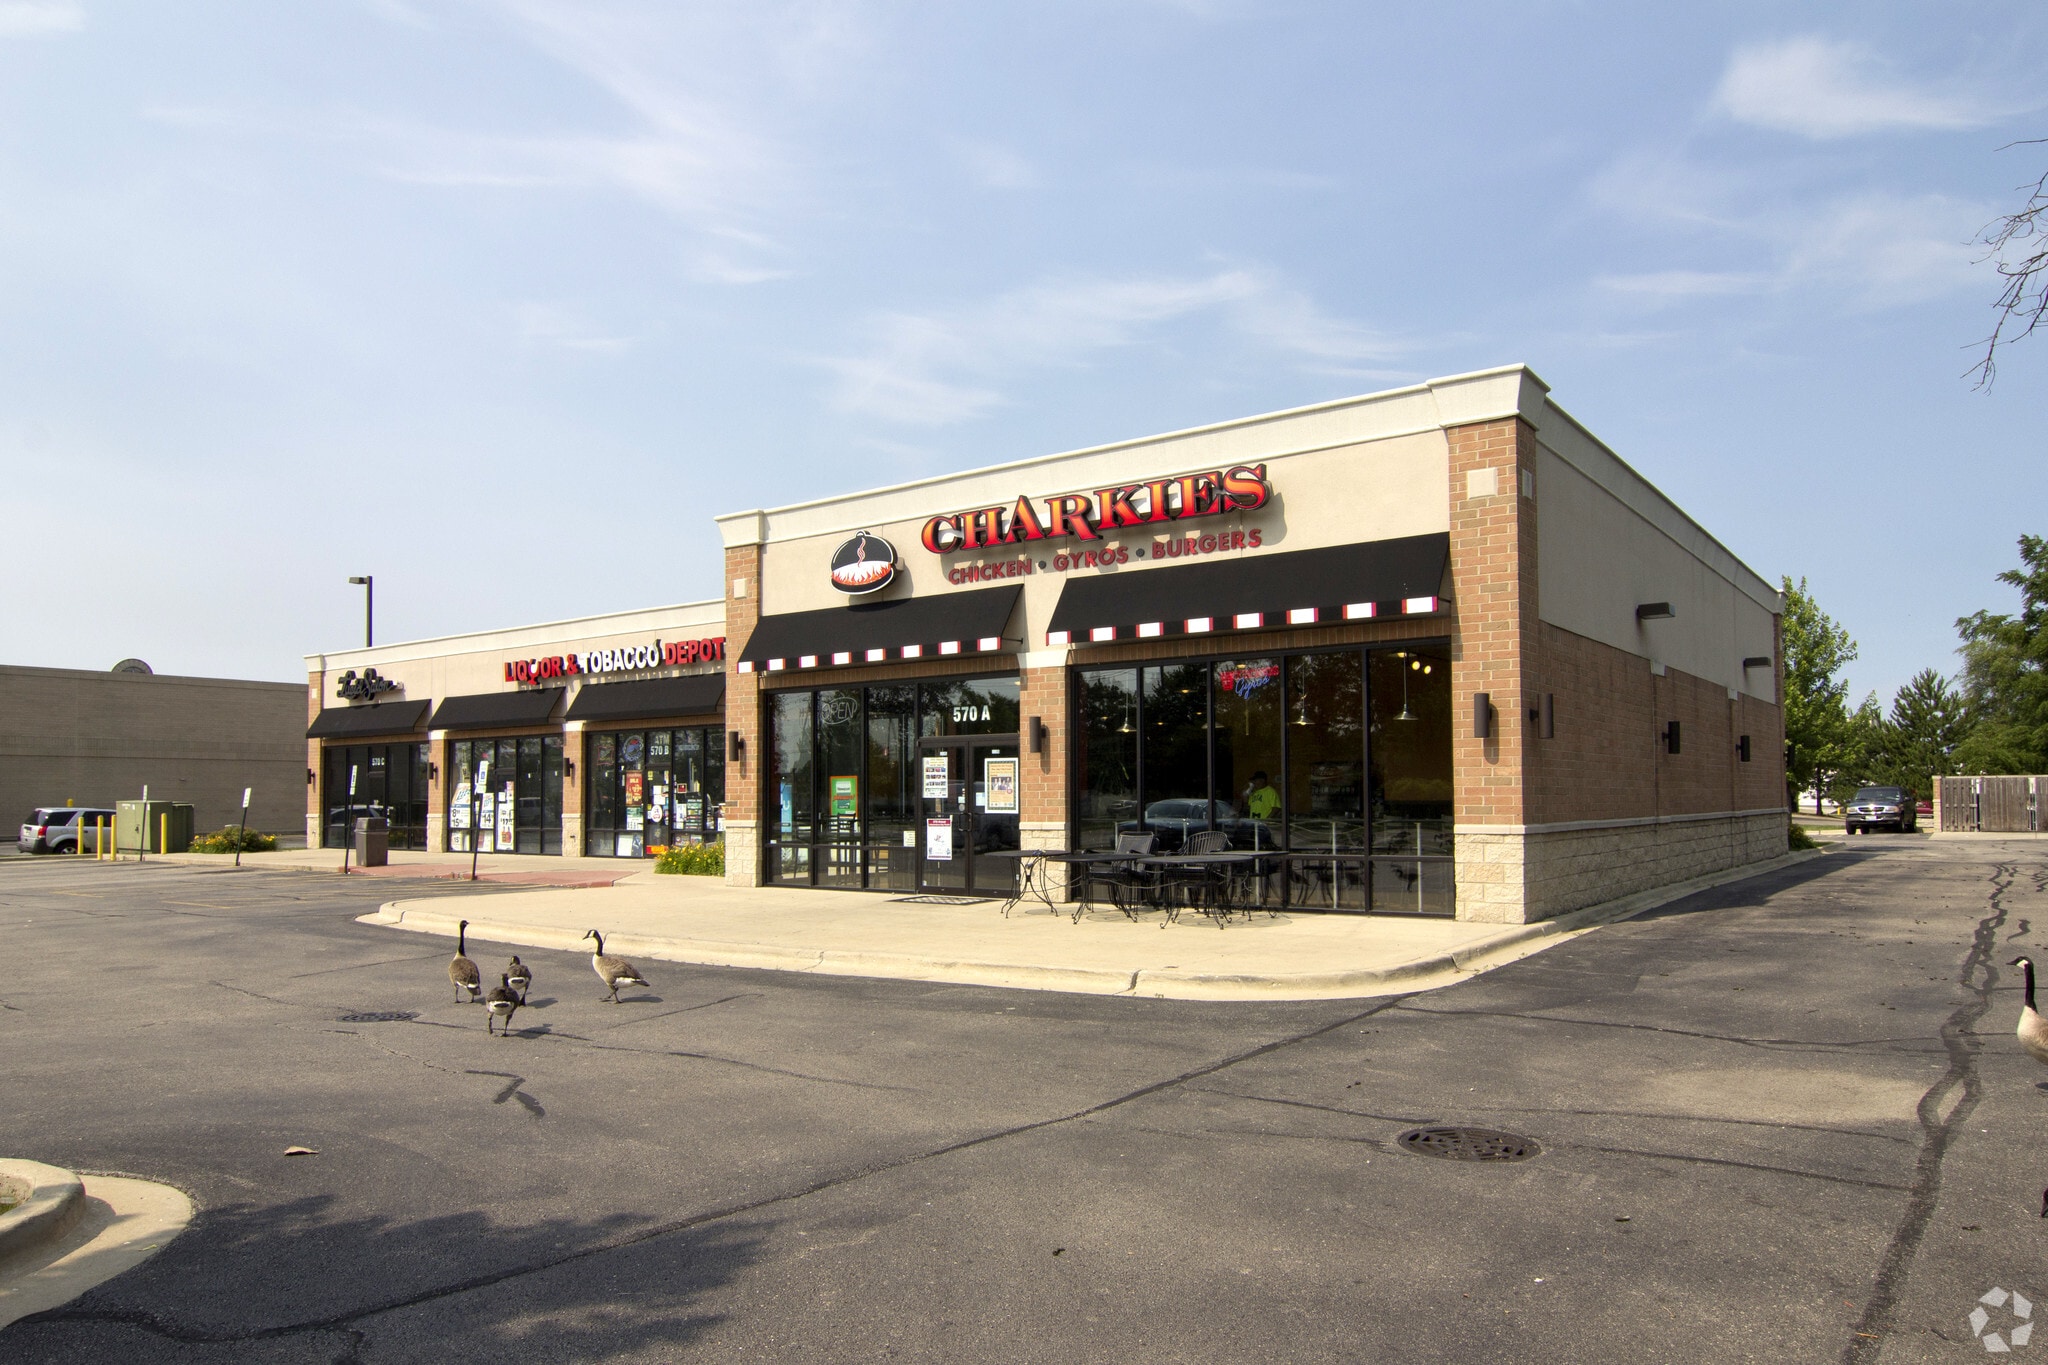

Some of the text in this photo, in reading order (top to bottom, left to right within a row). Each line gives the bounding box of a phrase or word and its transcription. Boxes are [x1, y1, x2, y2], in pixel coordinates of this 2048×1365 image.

[920, 463, 1268, 553] CHARKIES
[948, 528, 1263, 585] CHICKEN GYROS BURGERS
[504, 636, 726, 685] LIQUOR & TOBACCO DEPOT
[1235, 675, 1270, 700] Gyros
[821, 701, 854, 721] OPEN
[953, 705, 991, 722] 570 A
[650, 746, 663, 756] 570
[664, 745, 669, 755] B
[654, 734, 670, 745] ATM
